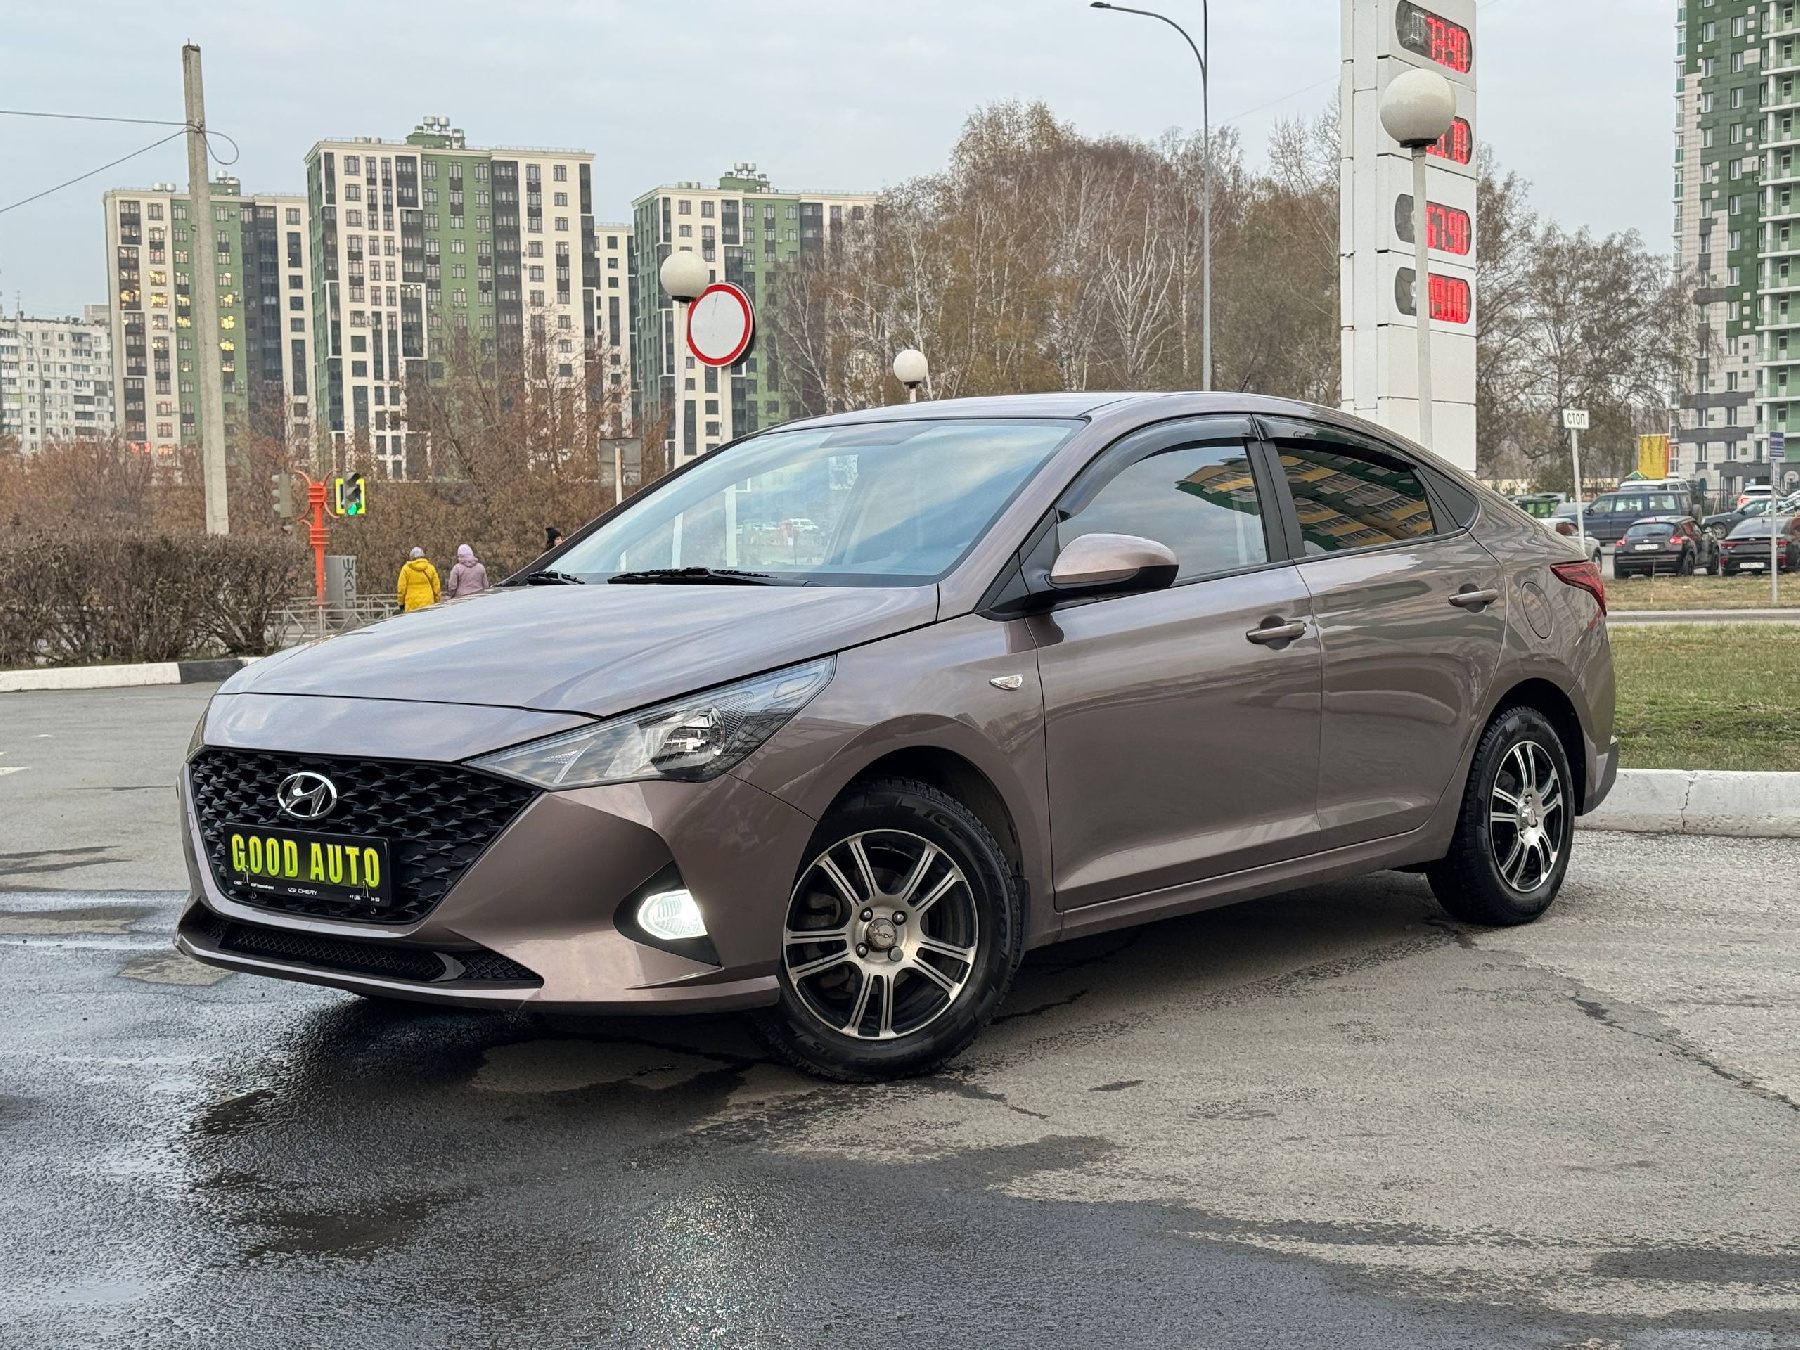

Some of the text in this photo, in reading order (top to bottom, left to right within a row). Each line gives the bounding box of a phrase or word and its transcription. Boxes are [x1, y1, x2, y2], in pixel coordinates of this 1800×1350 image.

[1567, 413, 1586, 426] СТОП
[231, 834, 380, 888] GOOD AUTO
